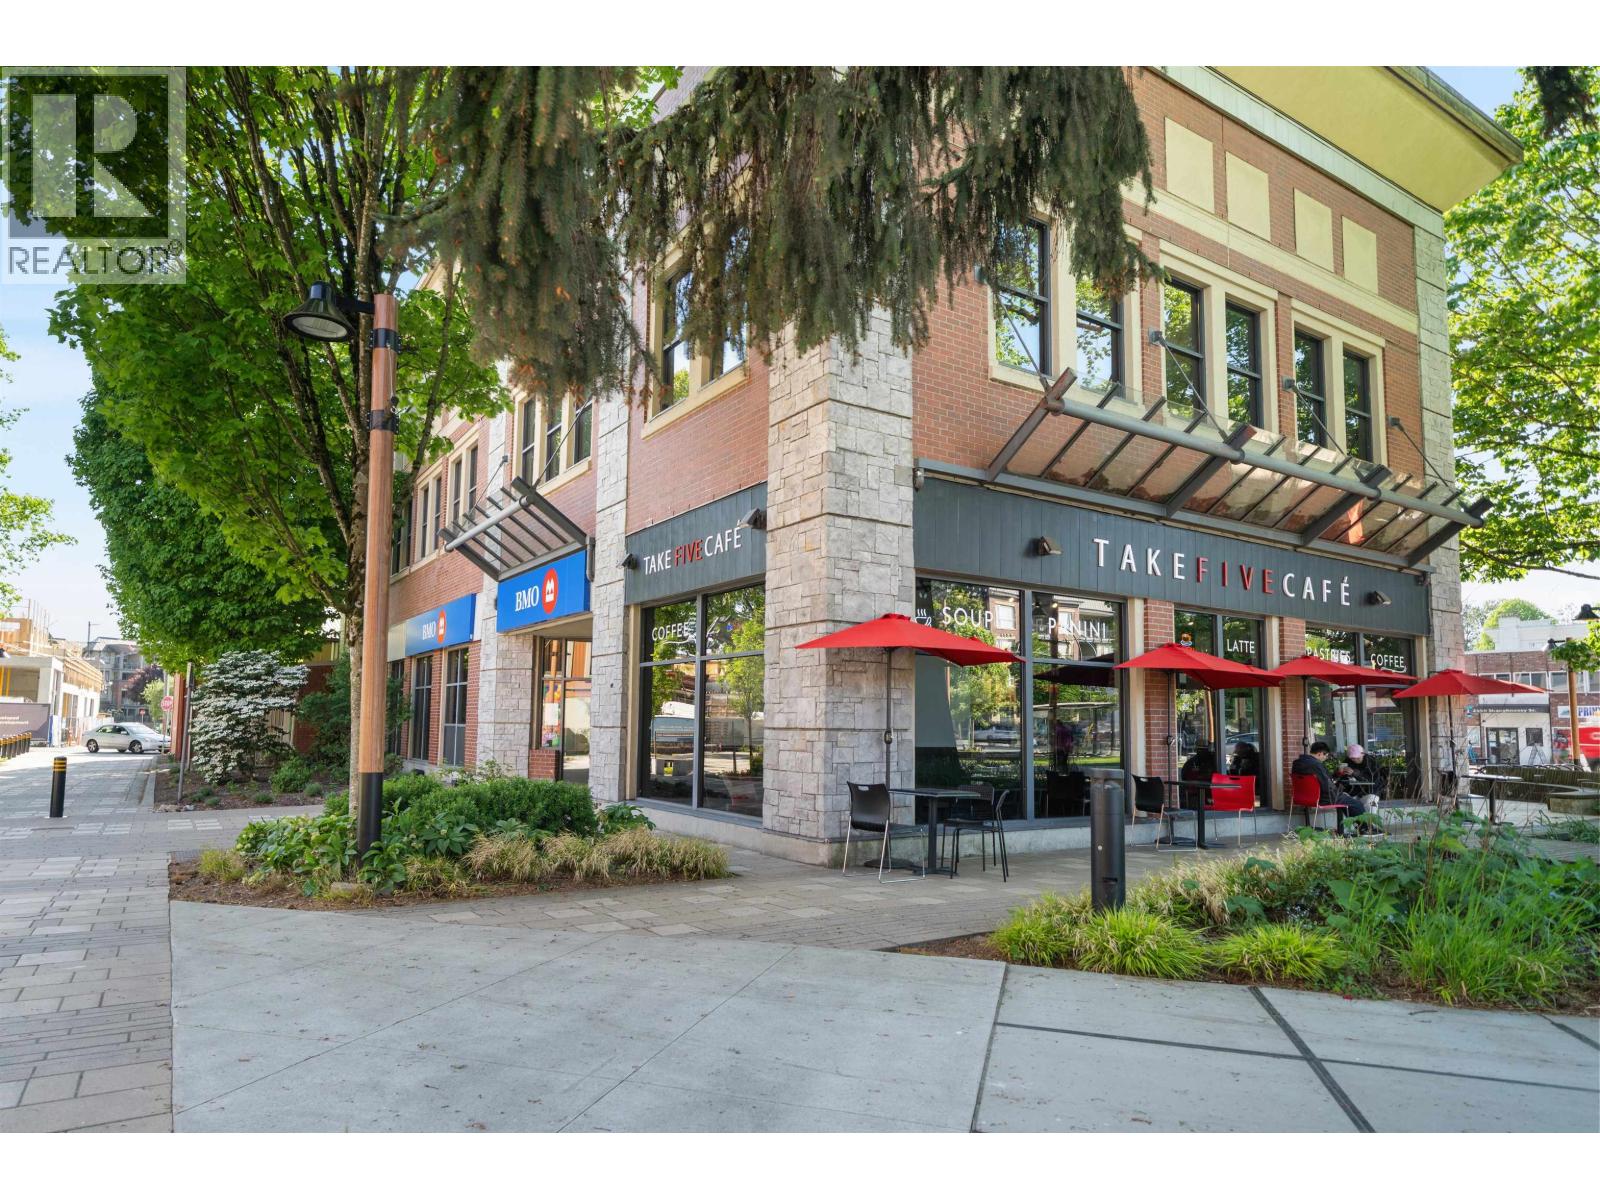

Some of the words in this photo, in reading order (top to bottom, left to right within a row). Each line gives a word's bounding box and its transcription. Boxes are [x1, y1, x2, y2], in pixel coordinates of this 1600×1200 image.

[644, 549, 672, 575] TAKE
[674, 539, 704, 567] FIVE
[704, 519, 742, 557] CAFÉ
[1093, 538, 1185, 580] TAKE
[1196, 556, 1275, 595] FIVE
[1282, 571, 1350, 606] CAFÉ
[515, 585, 540, 612] BMO
[942, 606, 994, 629] SOUP
[422, 620, 436, 640] BMO
[651, 621, 690, 641] COFFEE
[1226, 638, 1256, 654] LATTE
[1370, 653, 1406, 669] COFFEE
